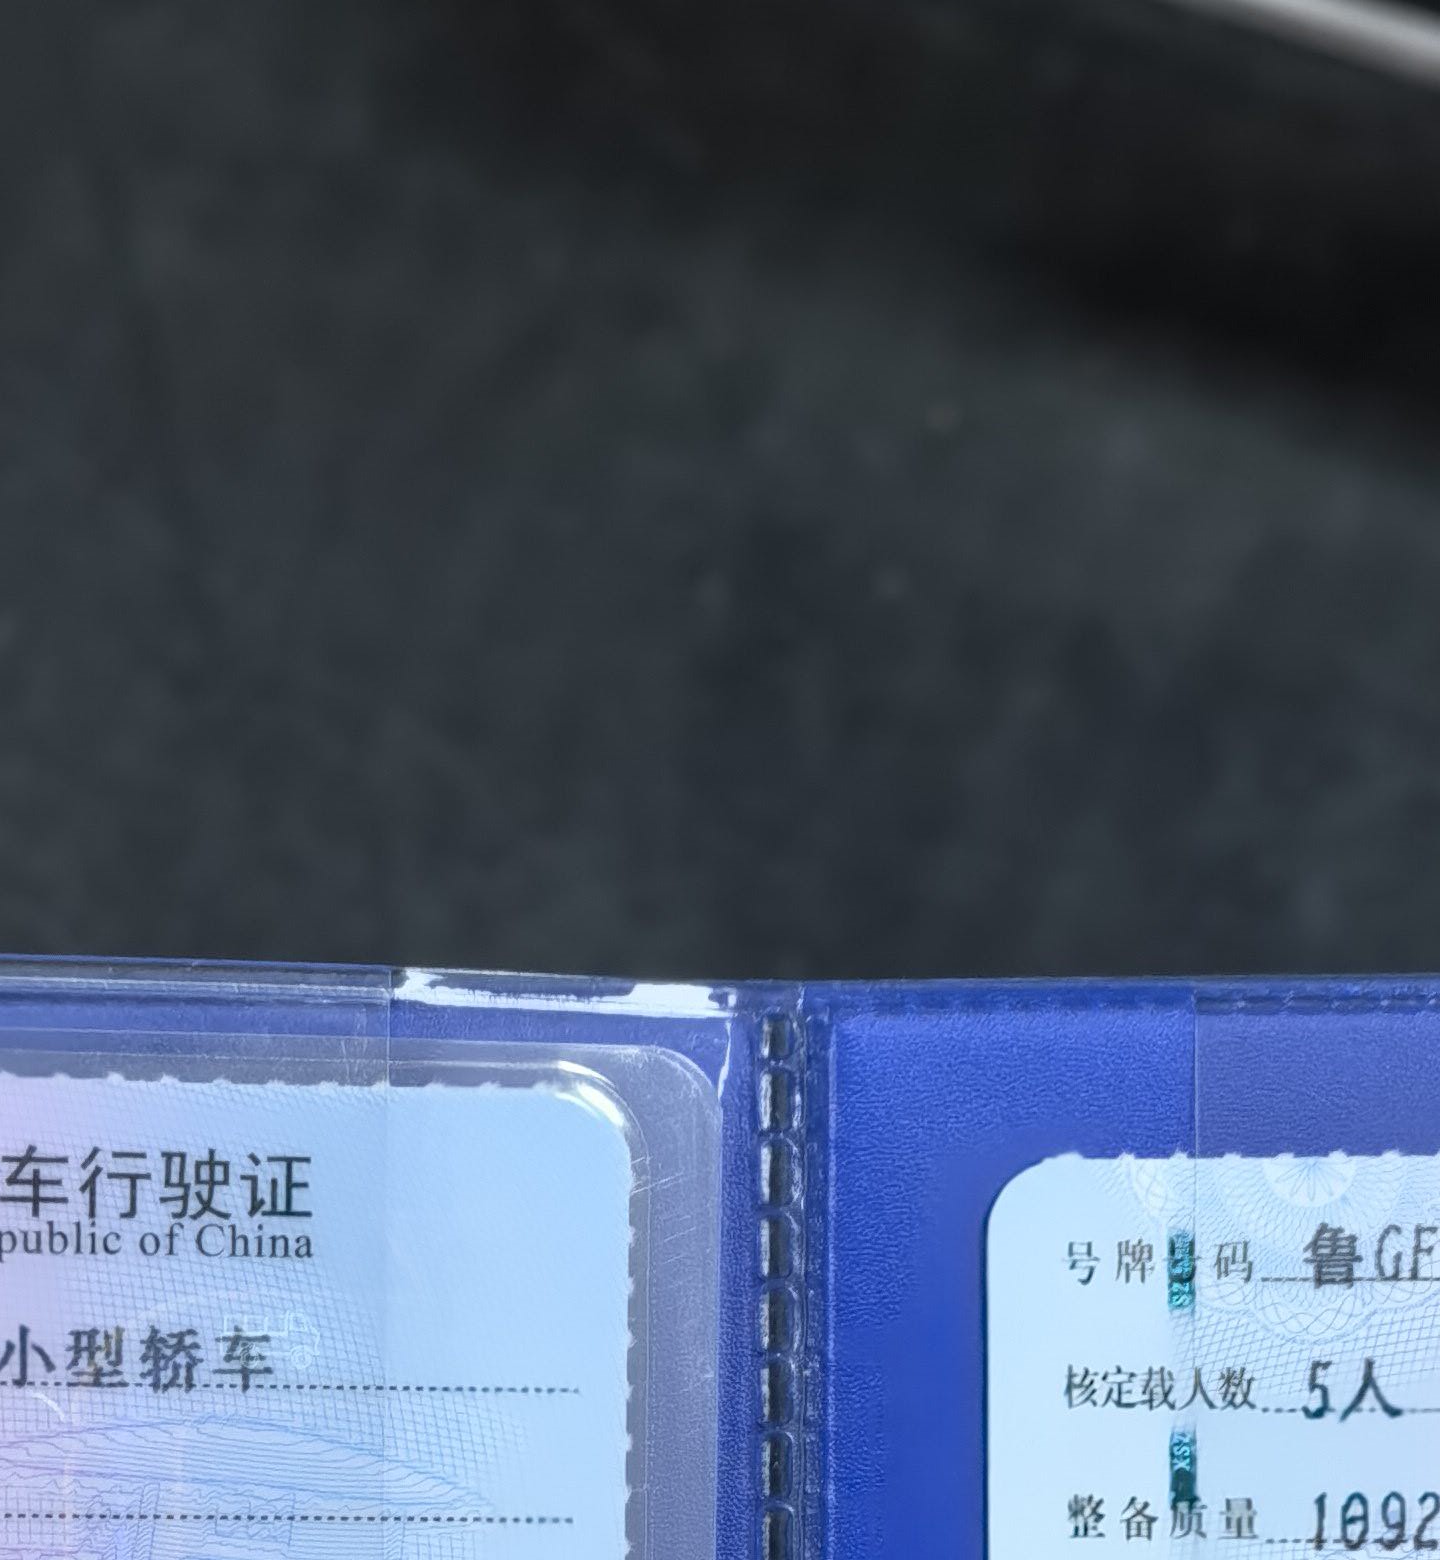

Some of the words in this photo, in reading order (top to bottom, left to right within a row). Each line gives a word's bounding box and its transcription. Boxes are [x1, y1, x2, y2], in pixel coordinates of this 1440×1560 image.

[138, 1221, 185, 1259] of
[194, 1222, 314, 1260] China
[1063, 1364, 1258, 1412] 核定载人数
[1304, 1359, 1404, 1421] 5人
[1066, 1496, 1259, 1542] 整备质量
